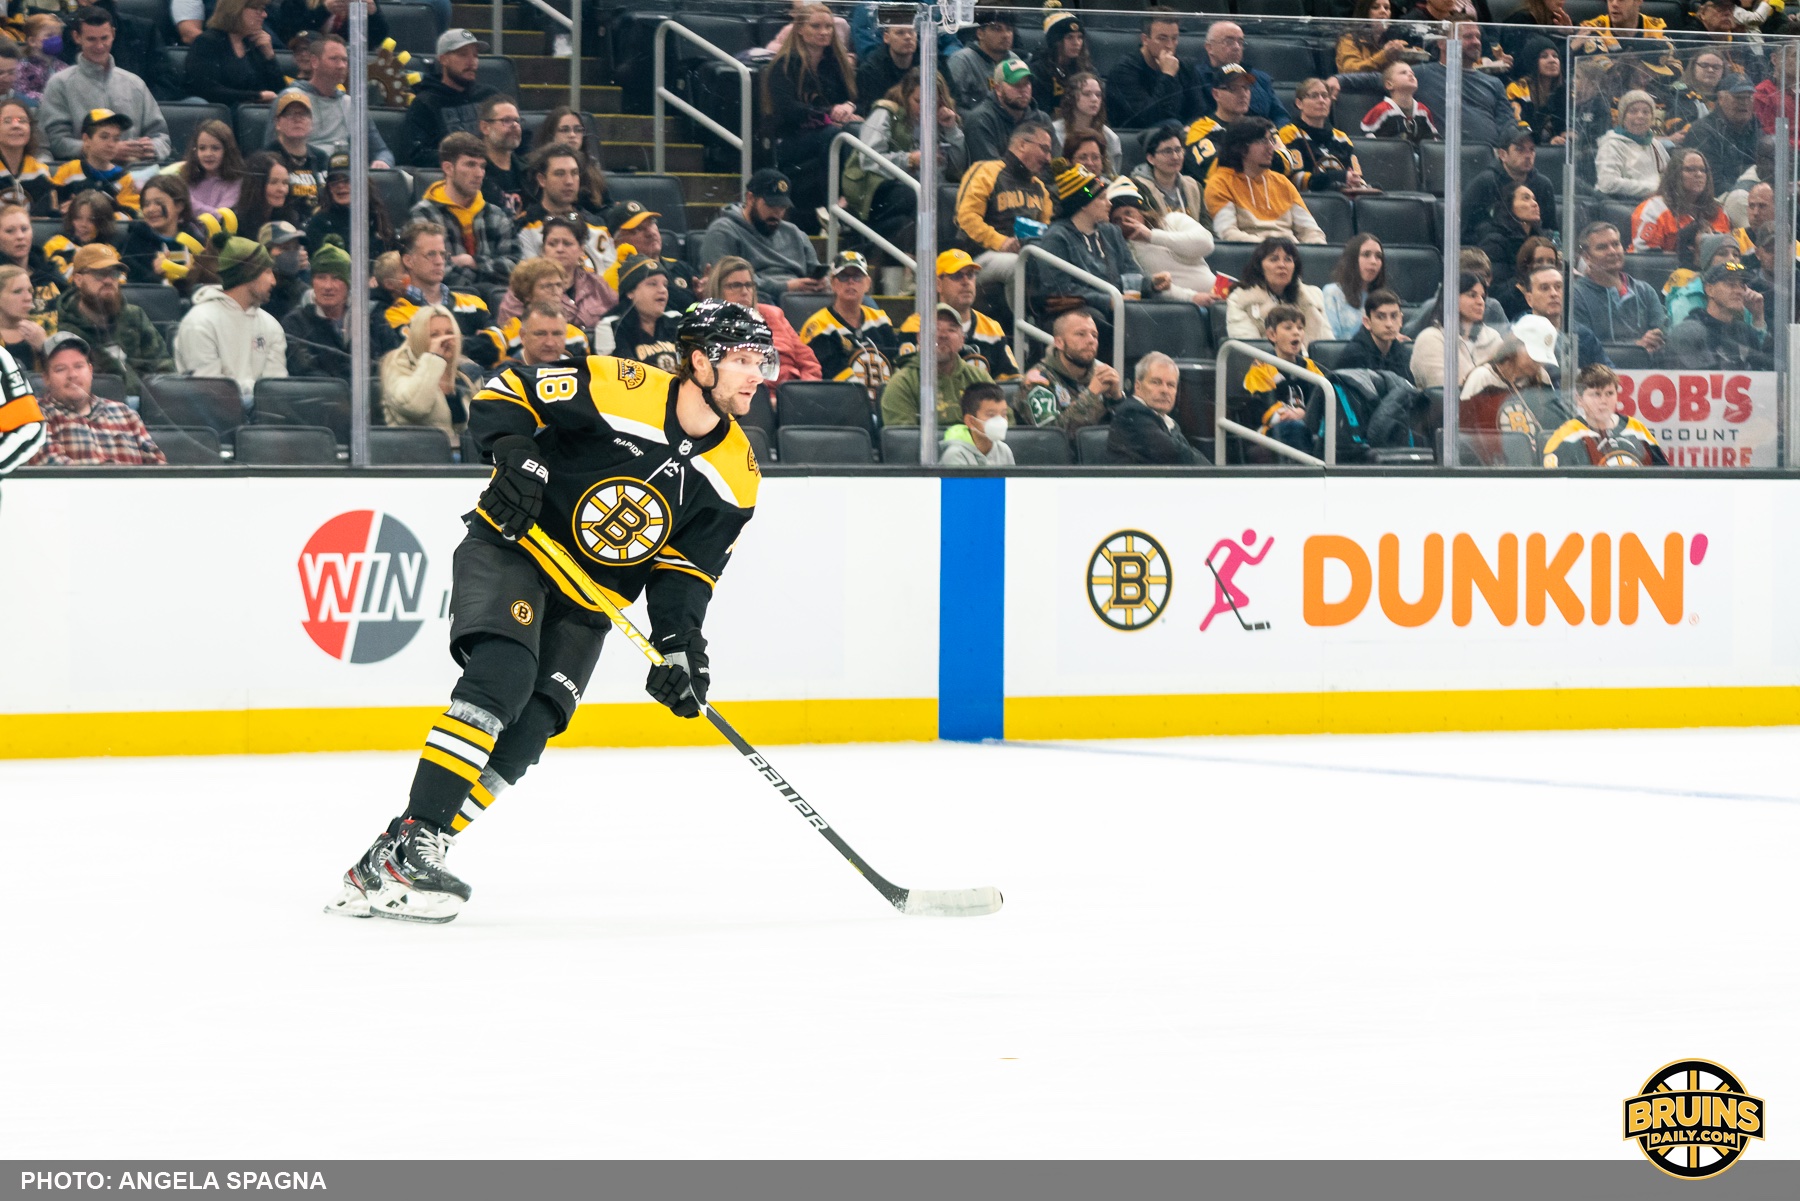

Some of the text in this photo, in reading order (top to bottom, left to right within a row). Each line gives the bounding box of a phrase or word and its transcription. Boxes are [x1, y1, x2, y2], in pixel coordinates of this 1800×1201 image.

[635, 340, 677, 361] BRUIN
[536, 367, 579, 404] 18
[1615, 373, 1753, 424] BOB'S
[1030, 397, 1054, 419] 37
[1302, 531, 1709, 629] DUNKIN'
